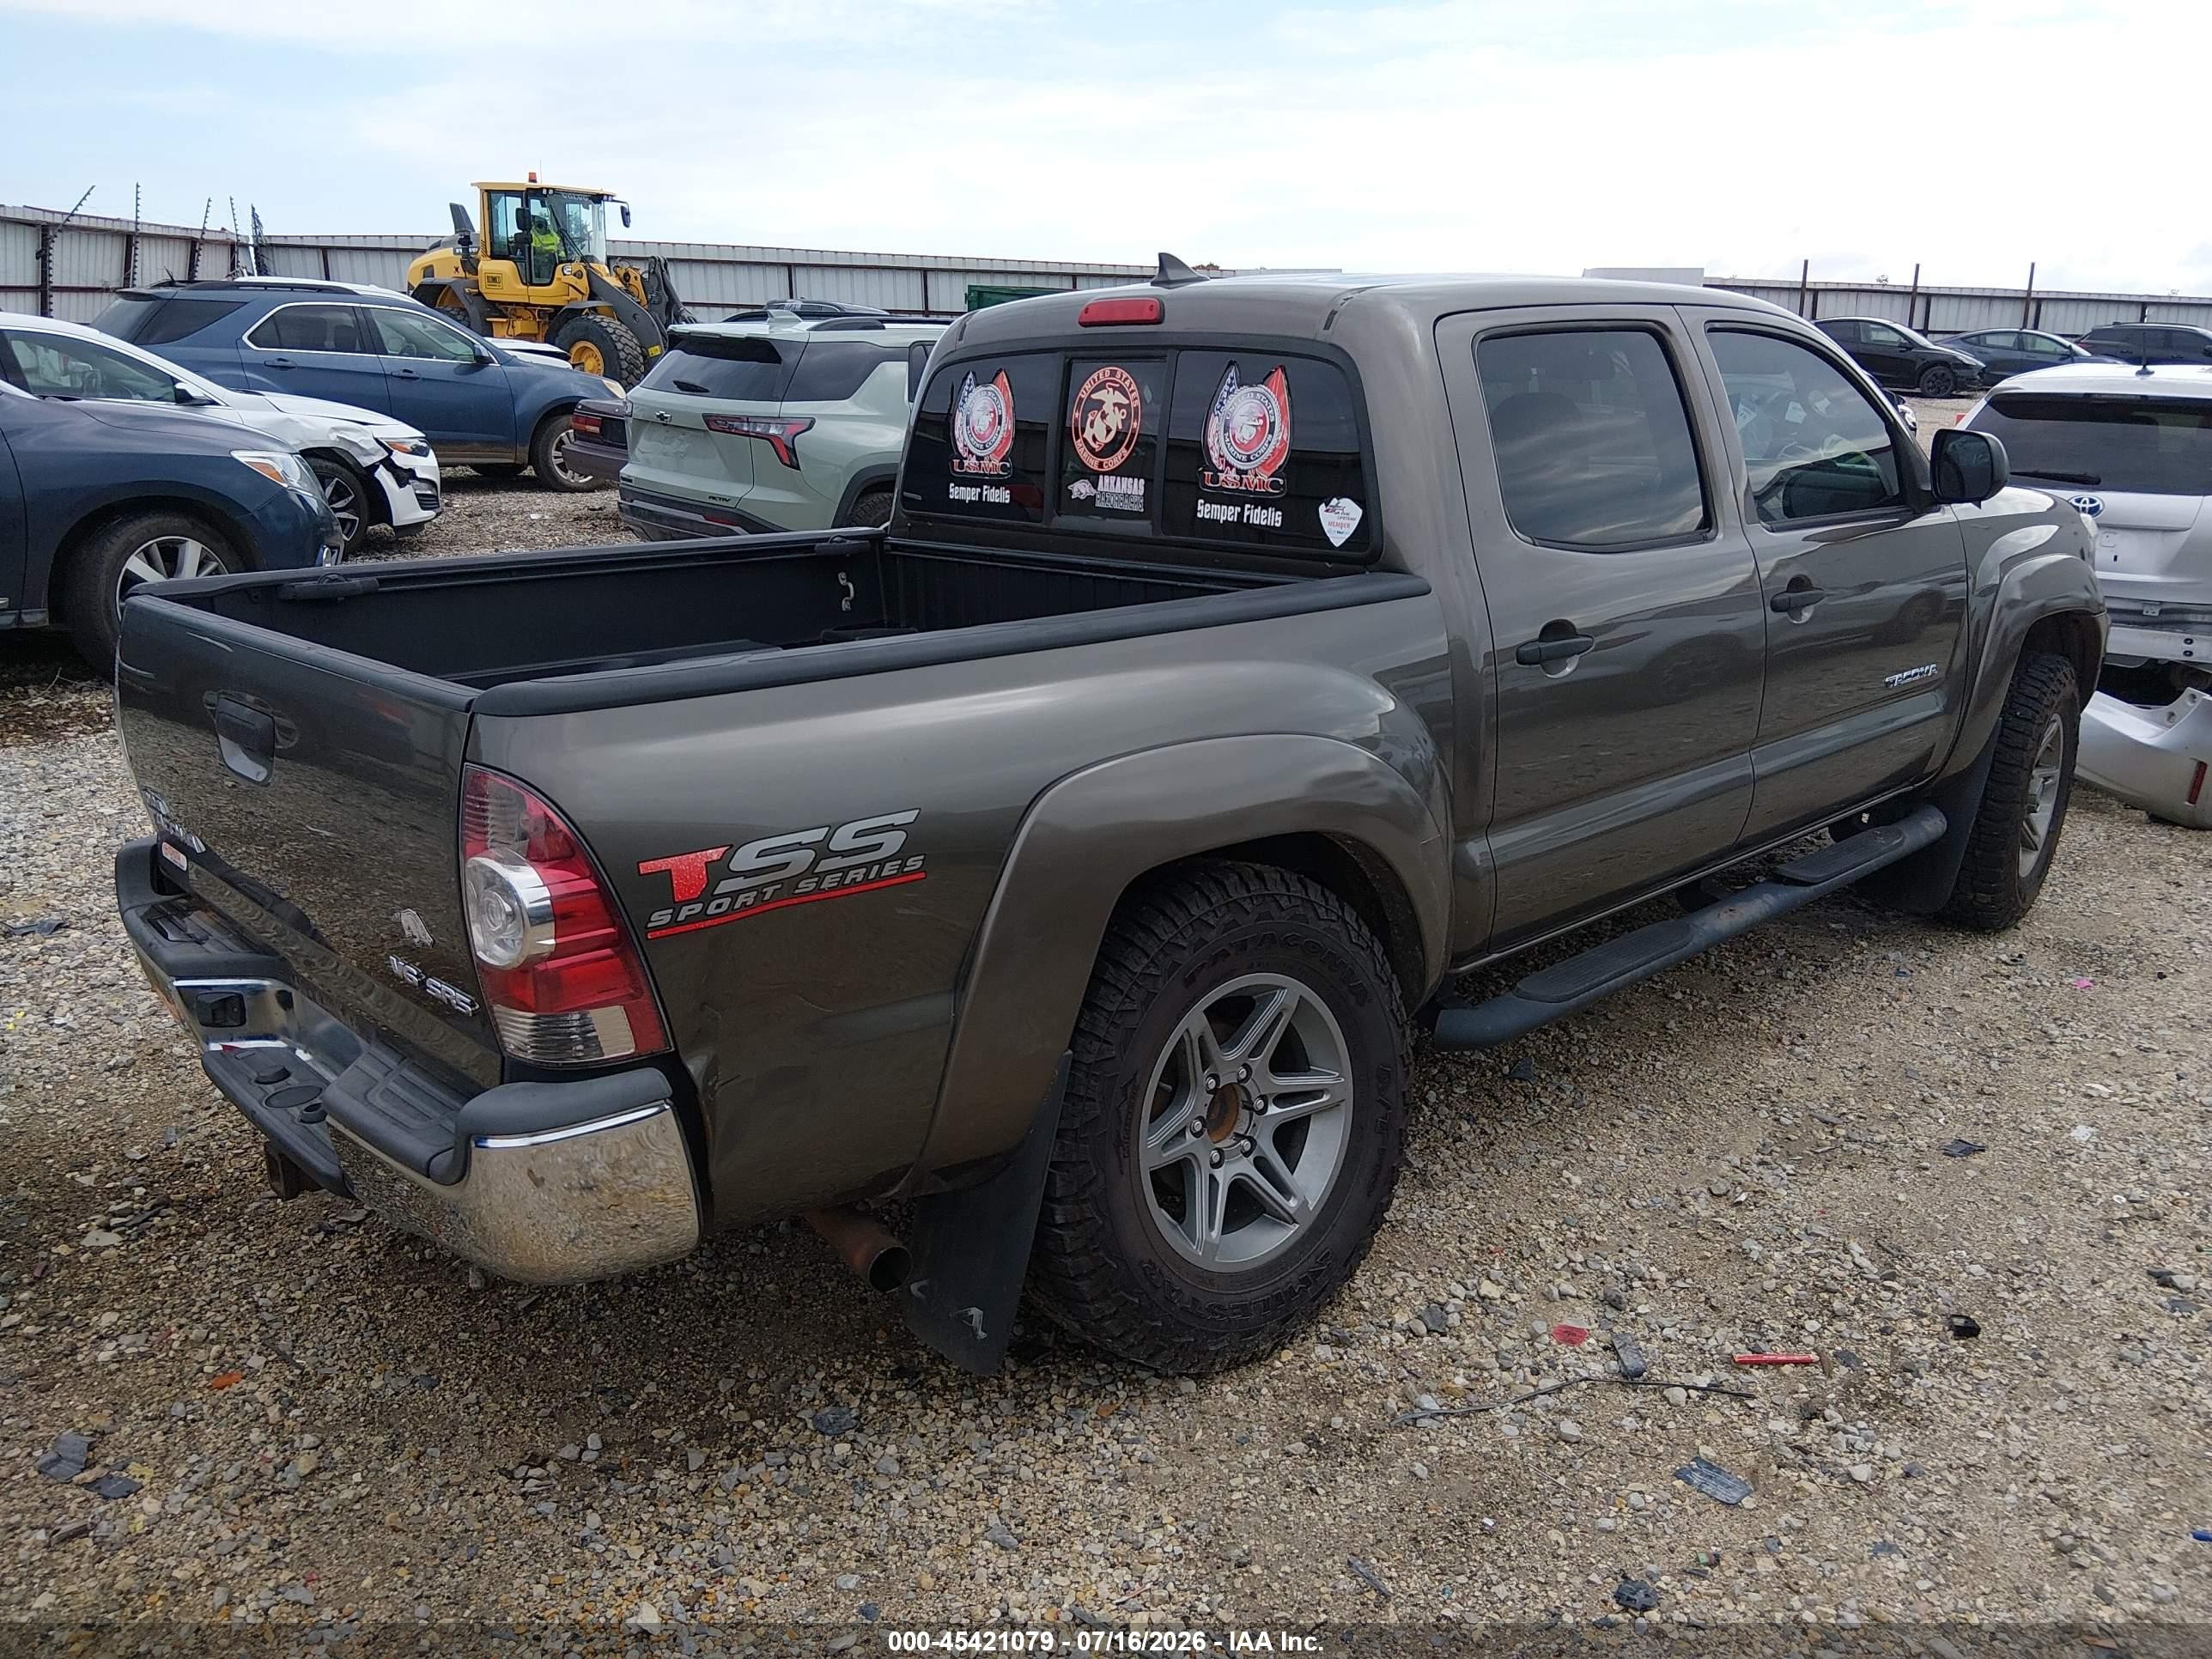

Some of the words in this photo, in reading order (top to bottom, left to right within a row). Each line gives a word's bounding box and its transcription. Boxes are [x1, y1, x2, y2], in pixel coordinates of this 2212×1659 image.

[1080, 369, 1111, 398] UNITED
[1115, 369, 1139, 407] STATES
[1256, 392, 1275, 422] STATES
[1076, 439, 1100, 469] MARINE
[1103, 447, 1128, 470] CORPS
[1224, 432, 1248, 462] MARINE
[1250, 433, 1273, 461] CORPS
[952, 459, 1011, 475] USMC
[949, 483, 981, 504] Semper
[982, 484, 1011, 504] Fidelis
[1097, 474, 1146, 495] ARKANSAS
[1203, 471, 1284, 493] USMC
[1095, 490, 1145, 512] RAZORBACKS
[1197, 499, 1241, 524] Semper
[1243, 504, 1283, 528] Fidelis
[637, 808, 921, 902] TSS
[646, 884, 782, 929] SPORT
[794, 854, 926, 895] SERIES
